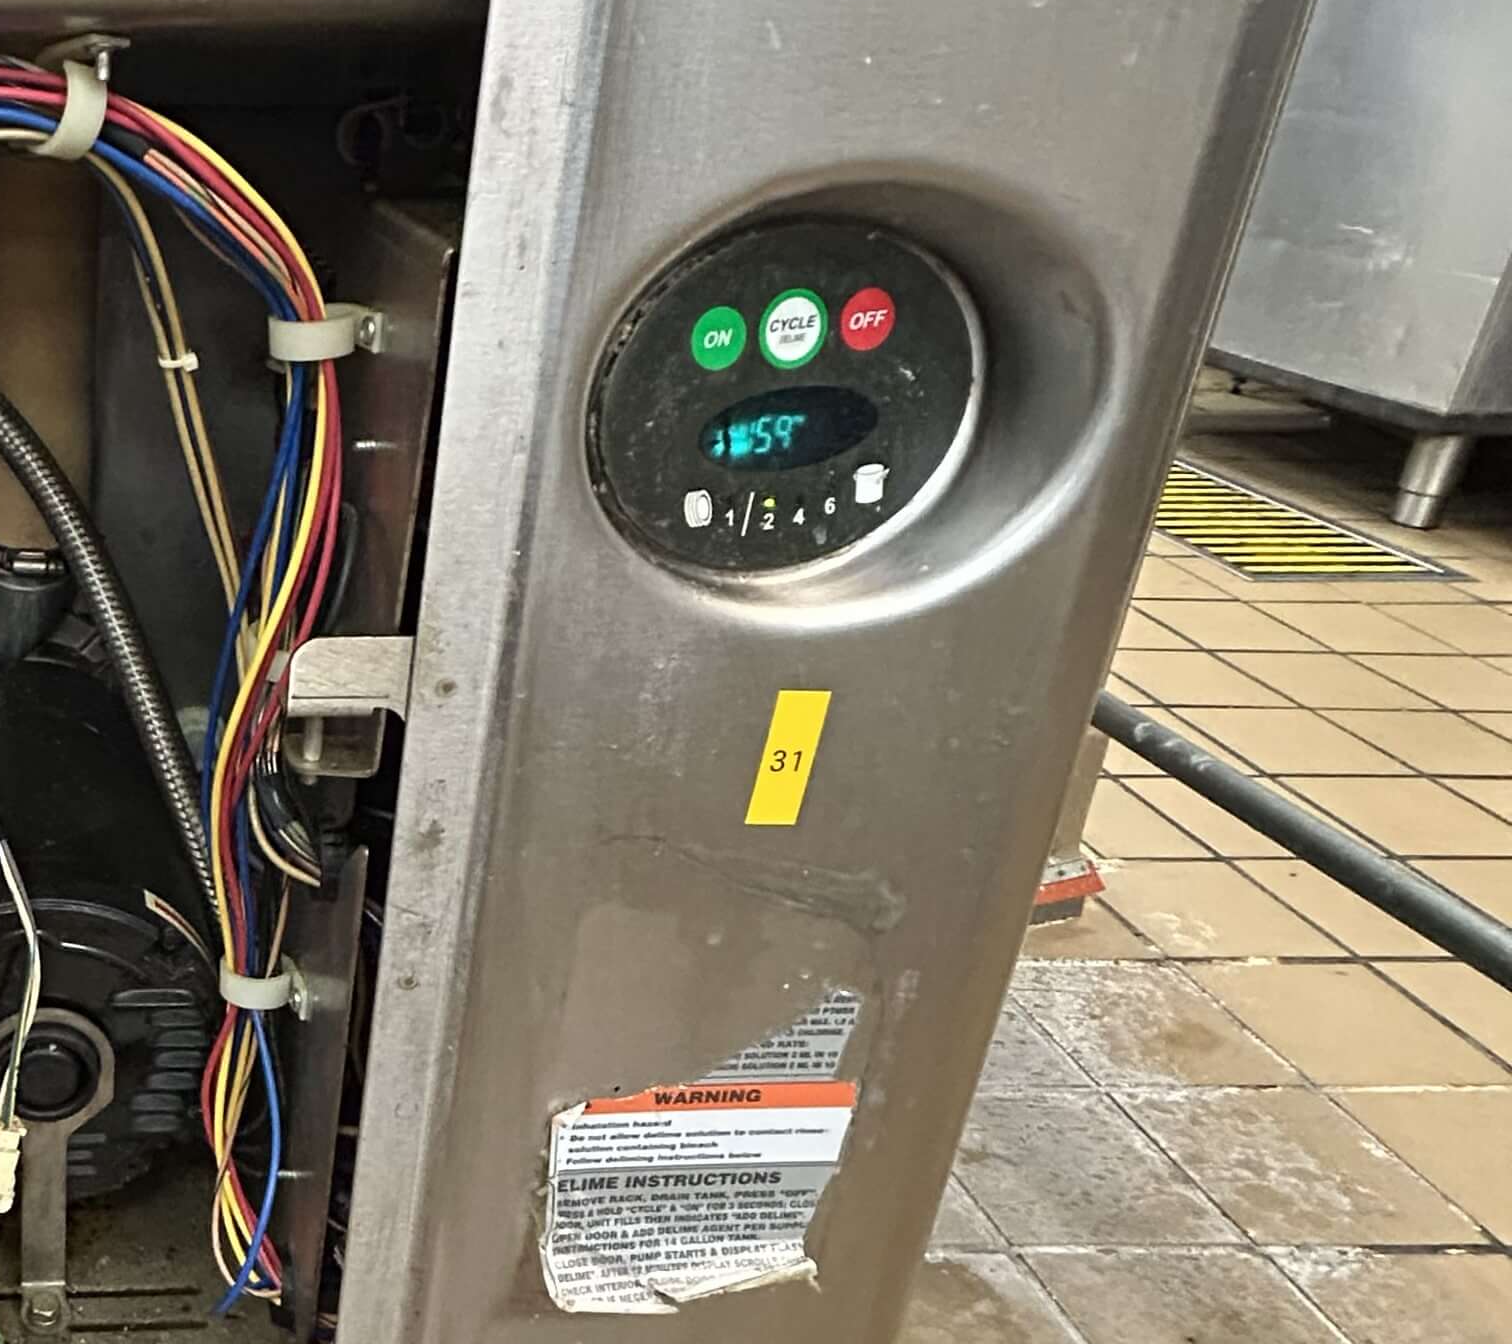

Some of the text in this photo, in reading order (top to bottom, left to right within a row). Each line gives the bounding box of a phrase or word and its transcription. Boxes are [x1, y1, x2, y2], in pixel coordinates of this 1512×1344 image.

[769, 314, 817, 333] CYCLE
[849, 309, 888, 331] OFF
[703, 328, 733, 349] ON
[824, 497, 836, 515] 6
[725, 508, 734, 527] 1
[761, 513, 775, 531] 2
[792, 507, 805, 526] 4
[769, 749, 803, 773] 31
[654, 1088, 761, 1106] WARNING
[624, 1171, 782, 1188] INSTRUCTIONS
